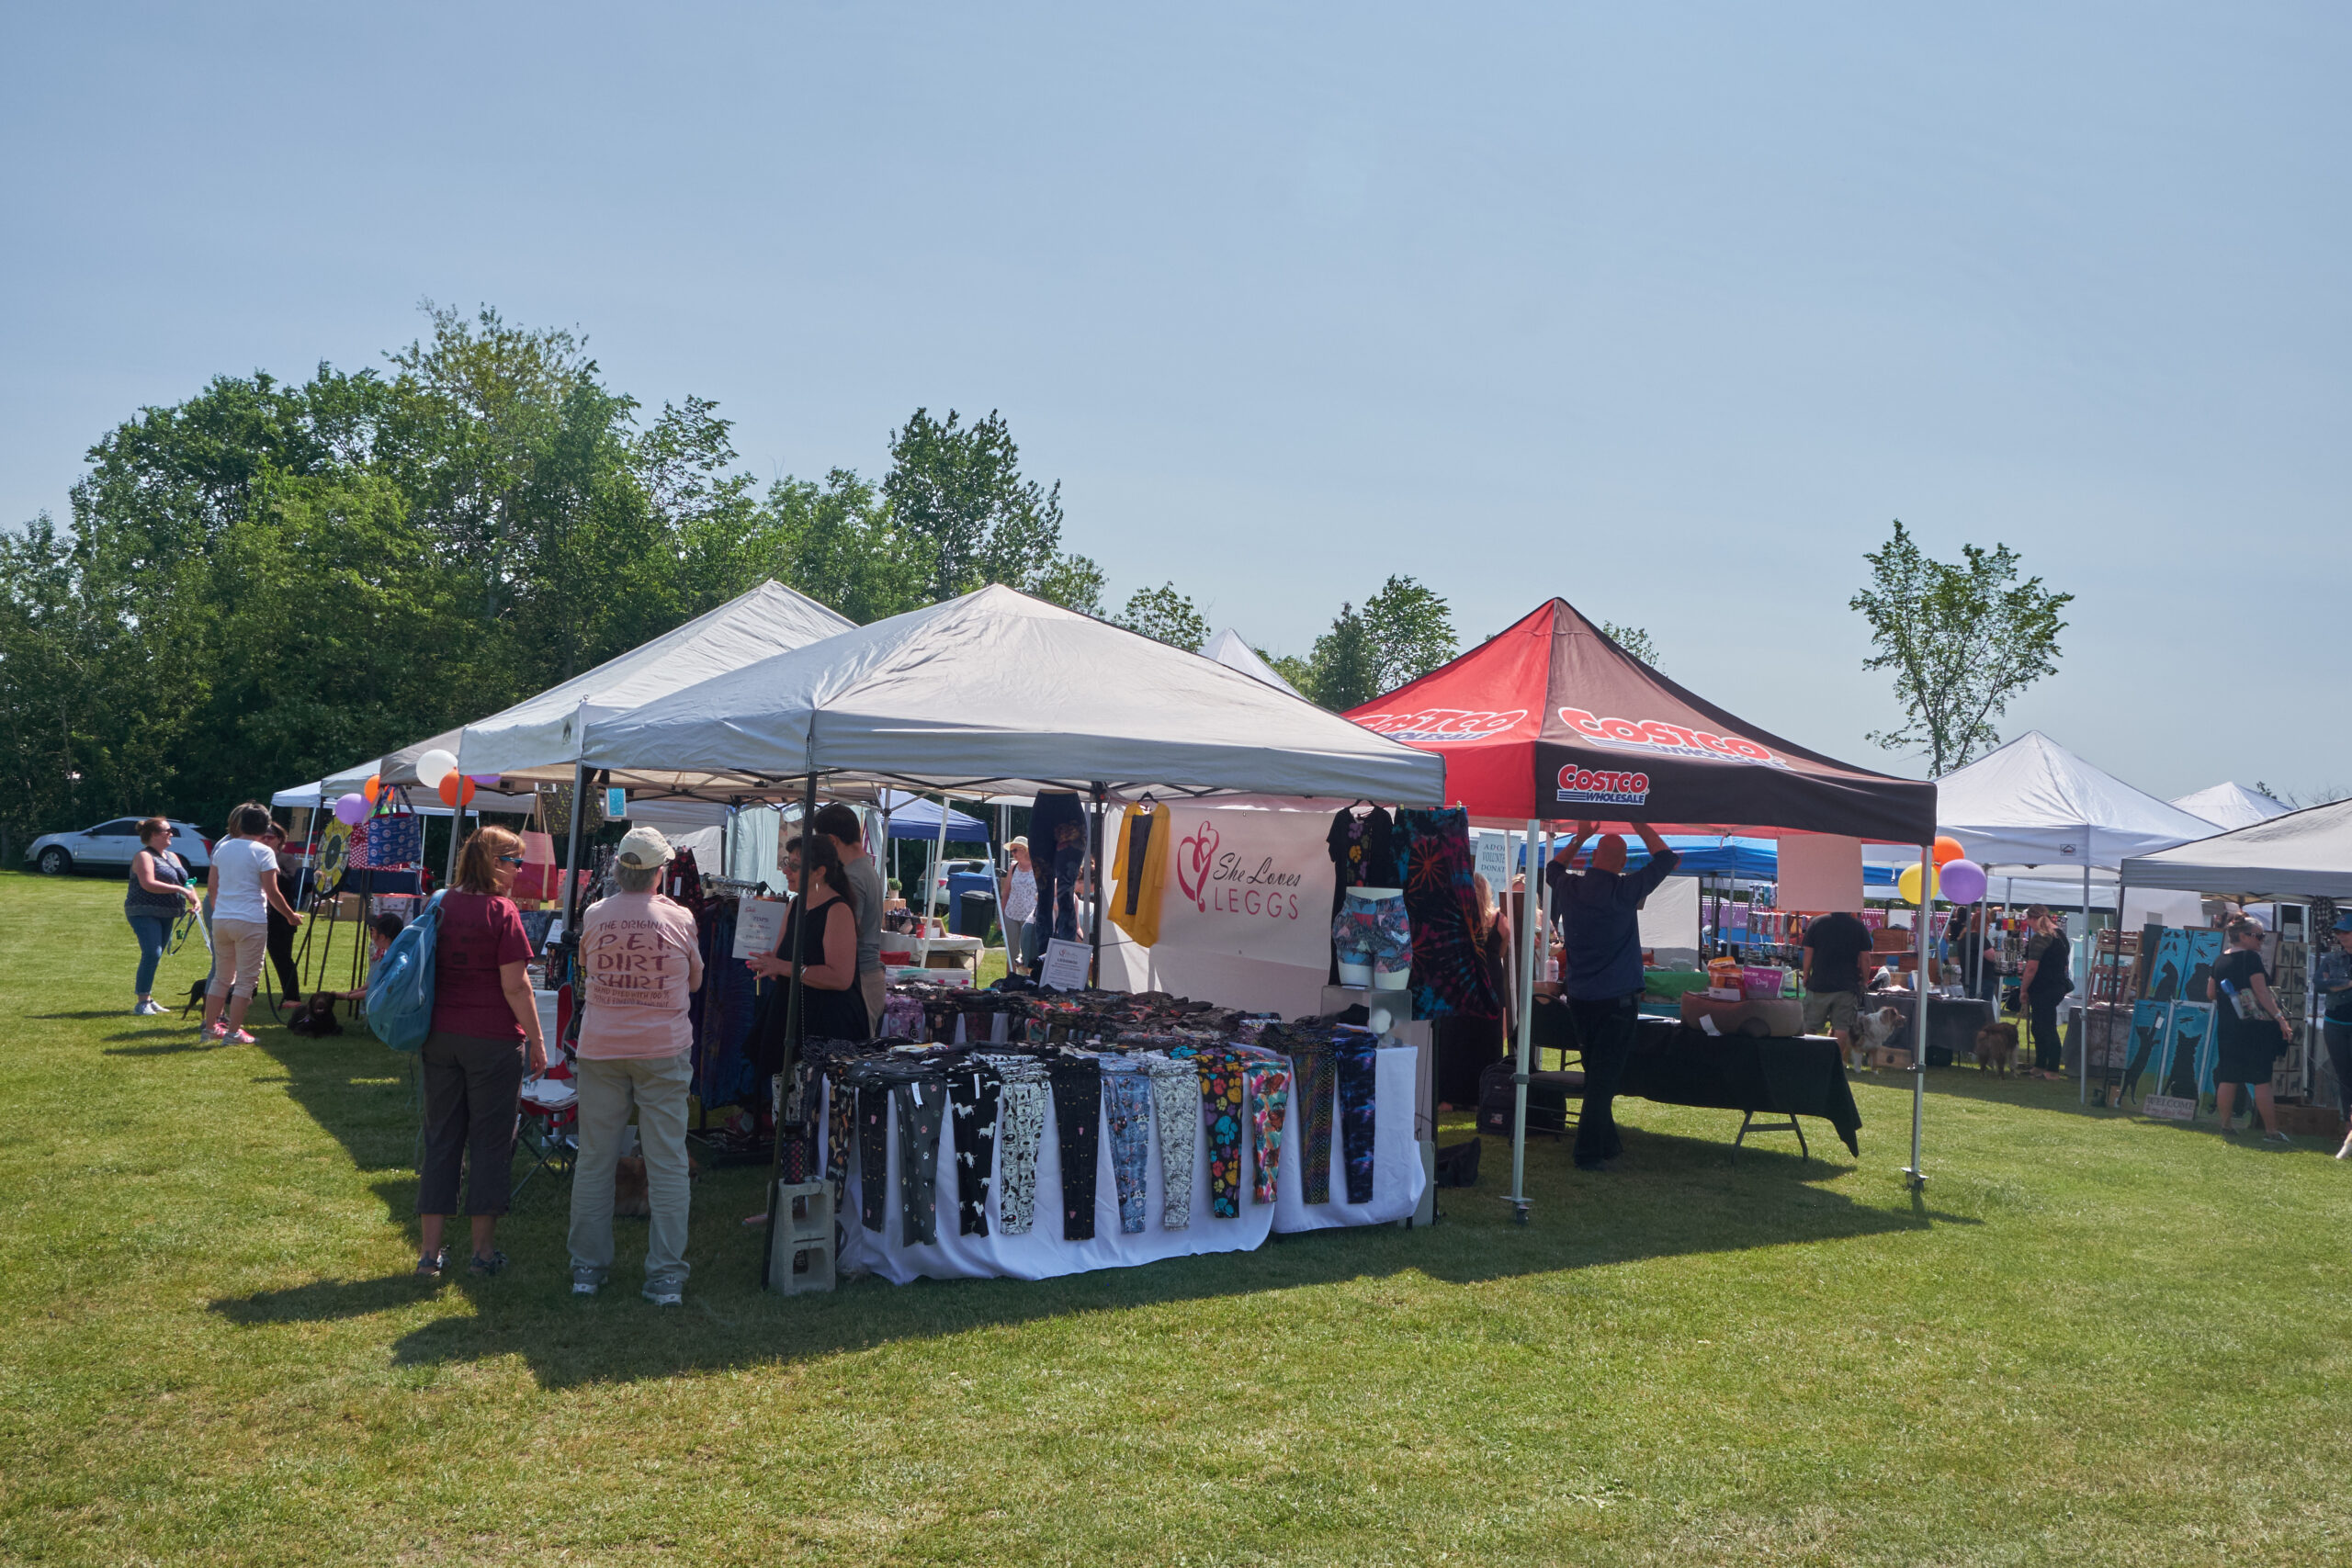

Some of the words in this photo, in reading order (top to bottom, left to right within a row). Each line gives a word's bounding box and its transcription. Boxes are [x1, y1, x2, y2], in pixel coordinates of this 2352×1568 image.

[1558, 706, 1773, 761] COSTCO
[1558, 764, 1649, 794] COSTCO
[1586, 792, 1645, 804] WHOLESALE
[1213, 852, 1245, 882] She
[1247, 856, 1301, 887] Loves
[1481, 864, 1507, 873] DONAT
[1215, 886, 1298, 920] LEGGS
[600, 920, 617, 931] THE
[597, 932, 672, 952] P.E.I.
[597, 953, 671, 972] DIRT
[591, 974, 670, 990] SHIRT
